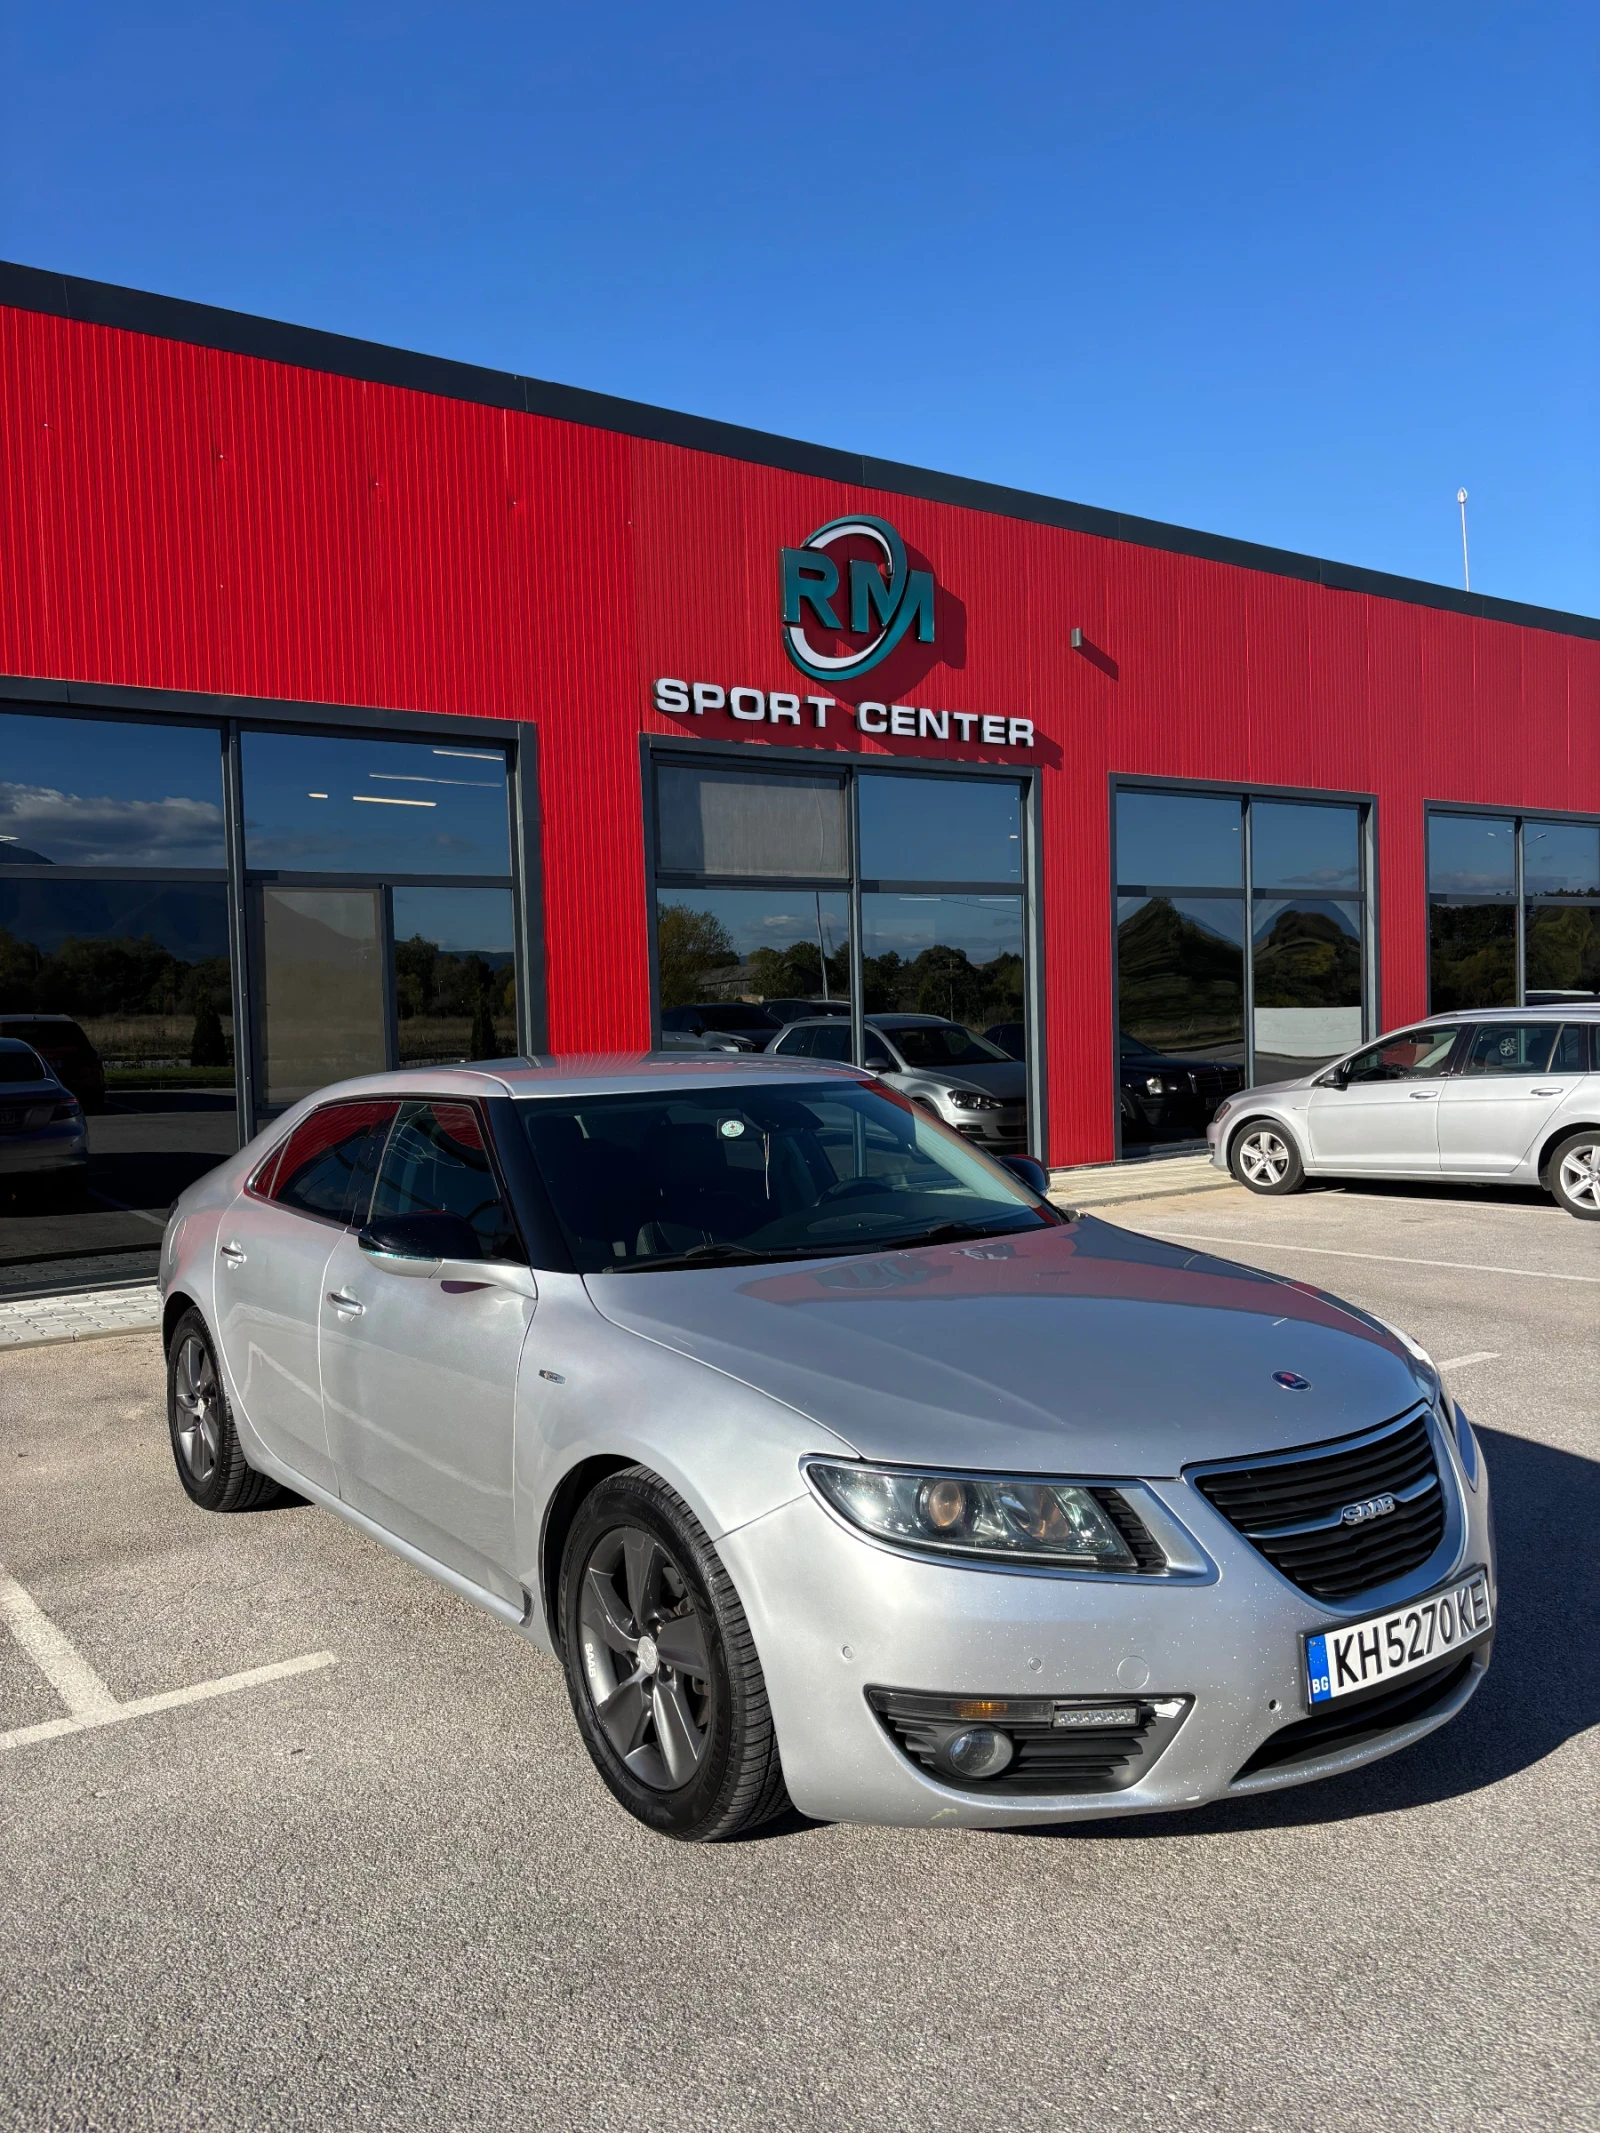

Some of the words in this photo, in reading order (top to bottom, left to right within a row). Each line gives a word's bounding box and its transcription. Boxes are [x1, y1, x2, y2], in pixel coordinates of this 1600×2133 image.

[779, 546, 935, 643] RM
[652, 677, 836, 728] SPORT
[856, 701, 1035, 747] CENTER
[1343, 1496, 1395, 1523] SAAB
[584, 1642, 596, 1678] SAAB
[1333, 1579, 1487, 1688] KH5270KE
[1312, 1675, 1329, 1694] BG
